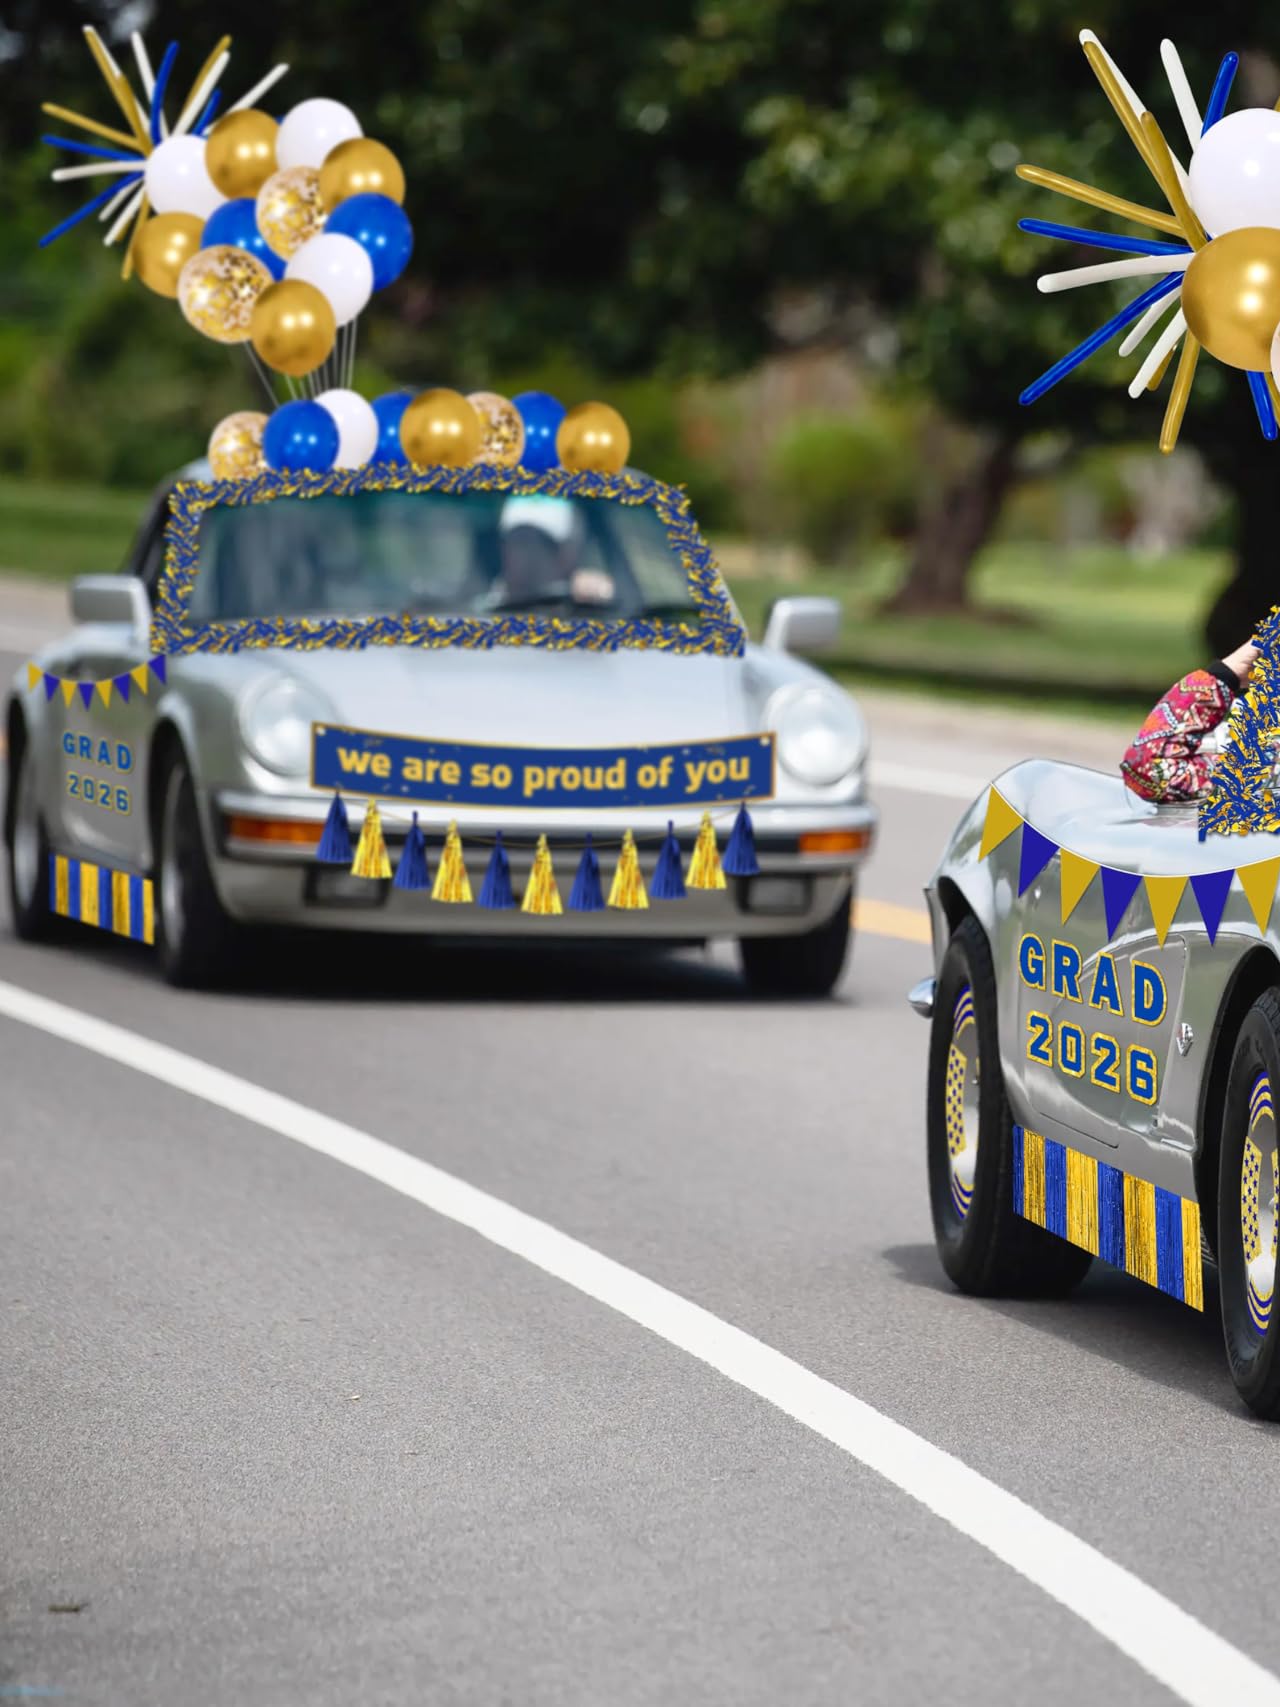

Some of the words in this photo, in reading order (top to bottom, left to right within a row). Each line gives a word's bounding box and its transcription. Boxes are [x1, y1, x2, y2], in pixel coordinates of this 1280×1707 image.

[62, 729, 135, 774] GRAD
[336, 746, 392, 778] we
[402, 756, 461, 786] are
[470, 763, 513, 789] so
[522, 757, 627, 798] proud
[636, 755, 674, 789] of
[684, 756, 751, 794] you
[65, 770, 131, 816] 2026
[1018, 932, 1167, 1027] GRAD
[1026, 1010, 1158, 1106] 2026
